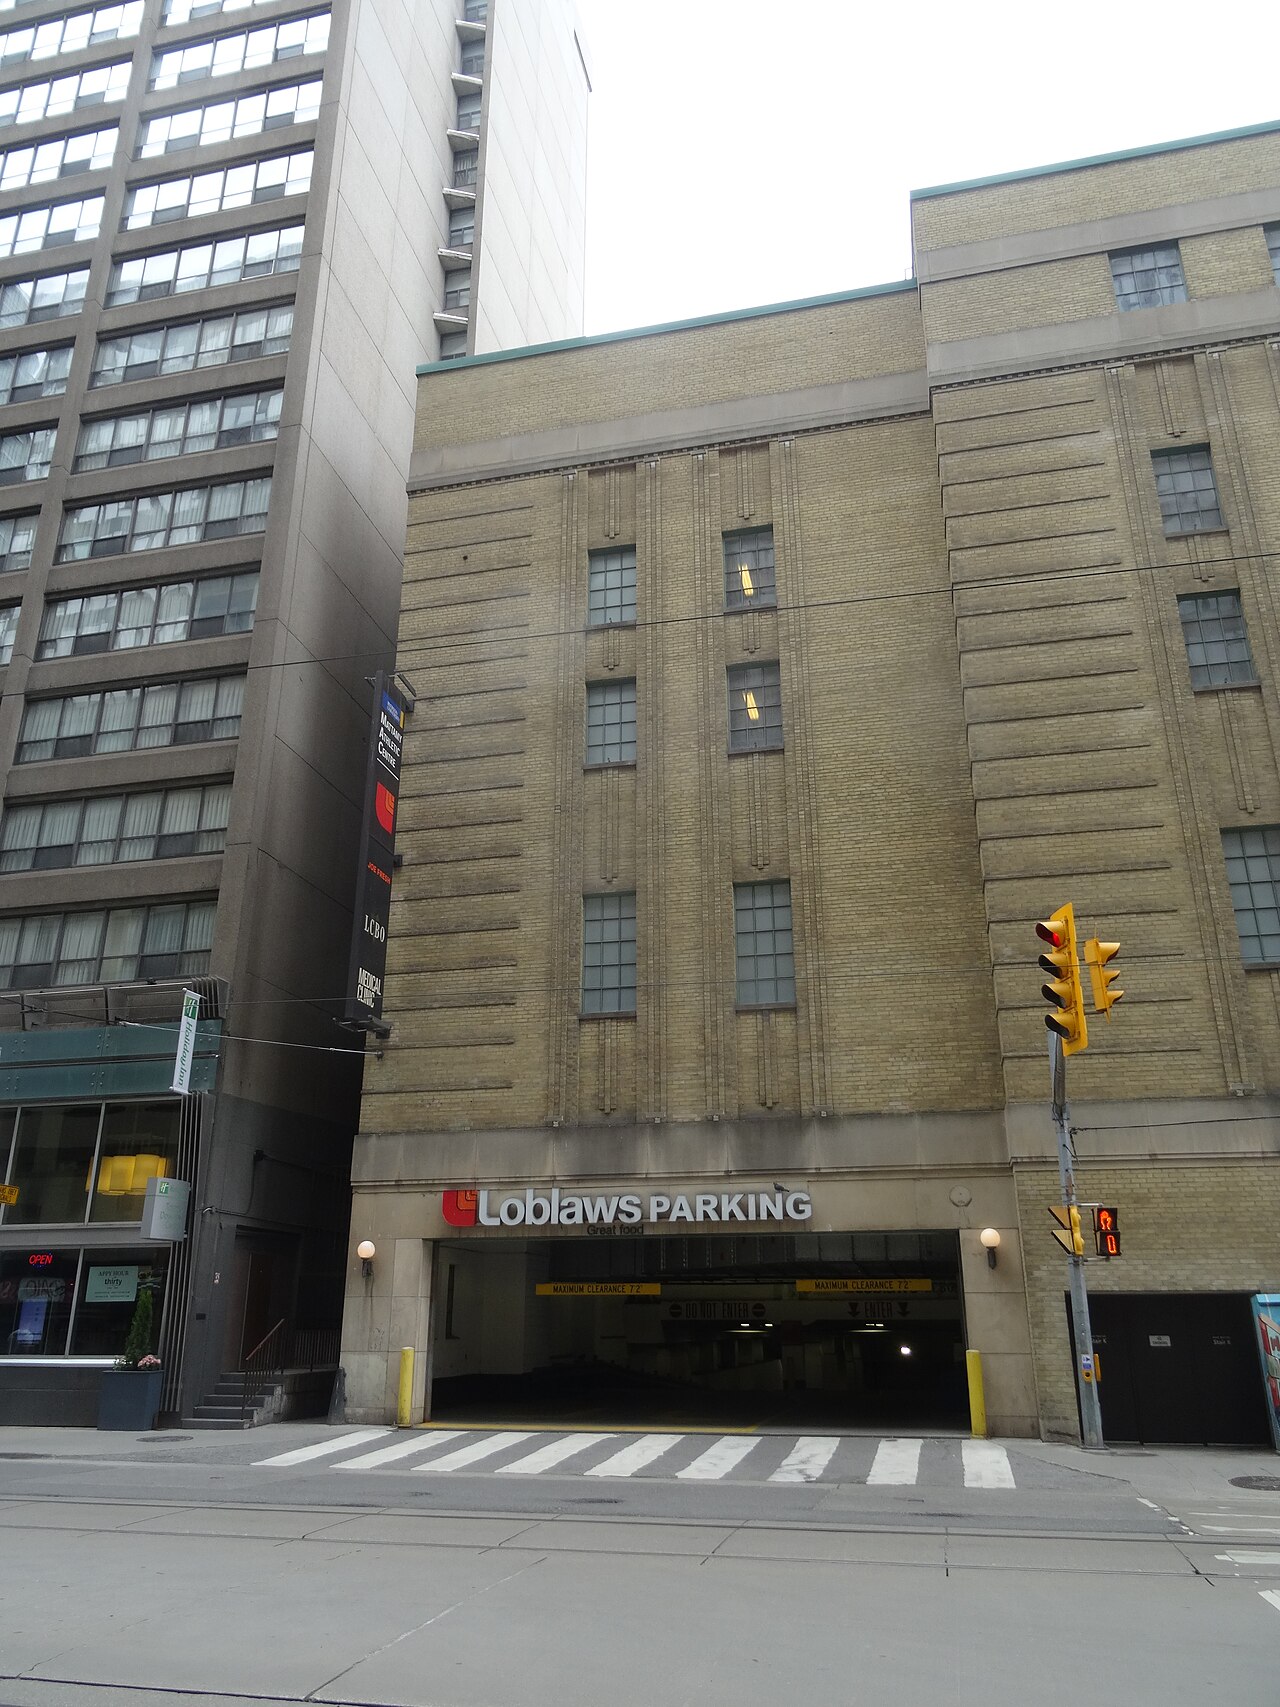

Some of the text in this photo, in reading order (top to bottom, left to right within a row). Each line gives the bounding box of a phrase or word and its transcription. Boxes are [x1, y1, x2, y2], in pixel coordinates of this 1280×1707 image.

[379, 726, 400, 757] ATHLETIC
[378, 741, 396, 768] CENTRE
[367, 862, 391, 885] JOE FRESH
[364, 914, 385, 943] LCBO
[358, 967, 382, 996] MEDICAL
[357, 984, 375, 1008] CLINIC
[178, 1021, 193, 1086] Holiday Inn
[478, 1187, 813, 1226] Loblaws PARKING
[587, 1224, 645, 1236] Great food
[29, 1254, 53, 1265] OPEN
[104, 1278, 122, 1286] thirty
[553, 1284, 584, 1293] MAXIMUM
[587, 1284, 626, 1293] CLEARANCE
[814, 1280, 849, 1290] MAXIMUM
[852, 1280, 894, 1289] CLEARANCE
[685, 1303, 749, 1318] DO NOT ENTER
[864, 1302, 893, 1318] ENTER
